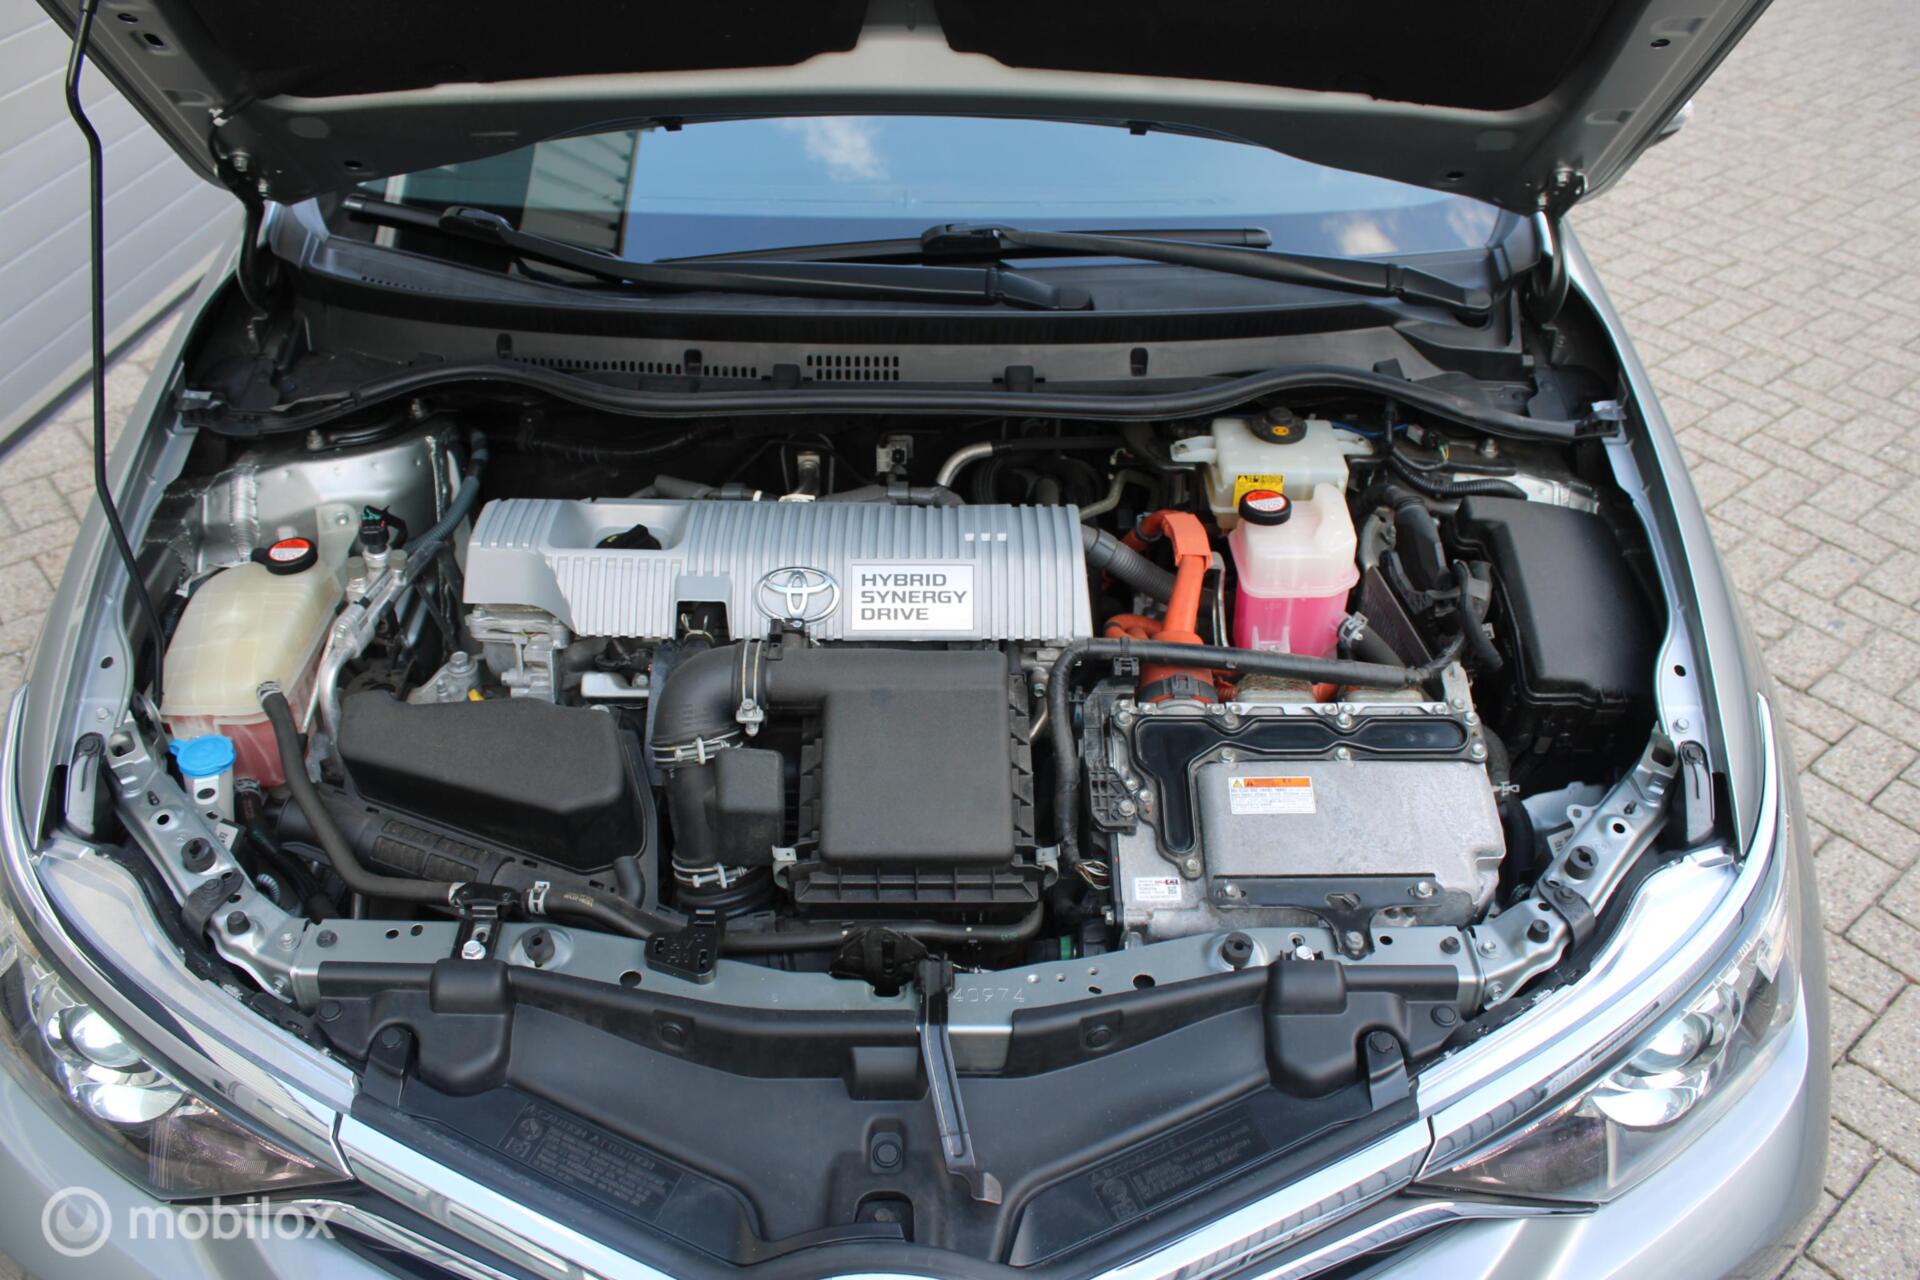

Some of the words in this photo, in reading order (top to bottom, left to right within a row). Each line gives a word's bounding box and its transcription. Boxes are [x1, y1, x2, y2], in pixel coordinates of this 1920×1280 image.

[861, 573, 947, 587] HYBRID
[860, 590, 967, 604] SYNERGY
[860, 607, 929, 621] DRIVE
[952, 987, 1025, 1003] 40974
